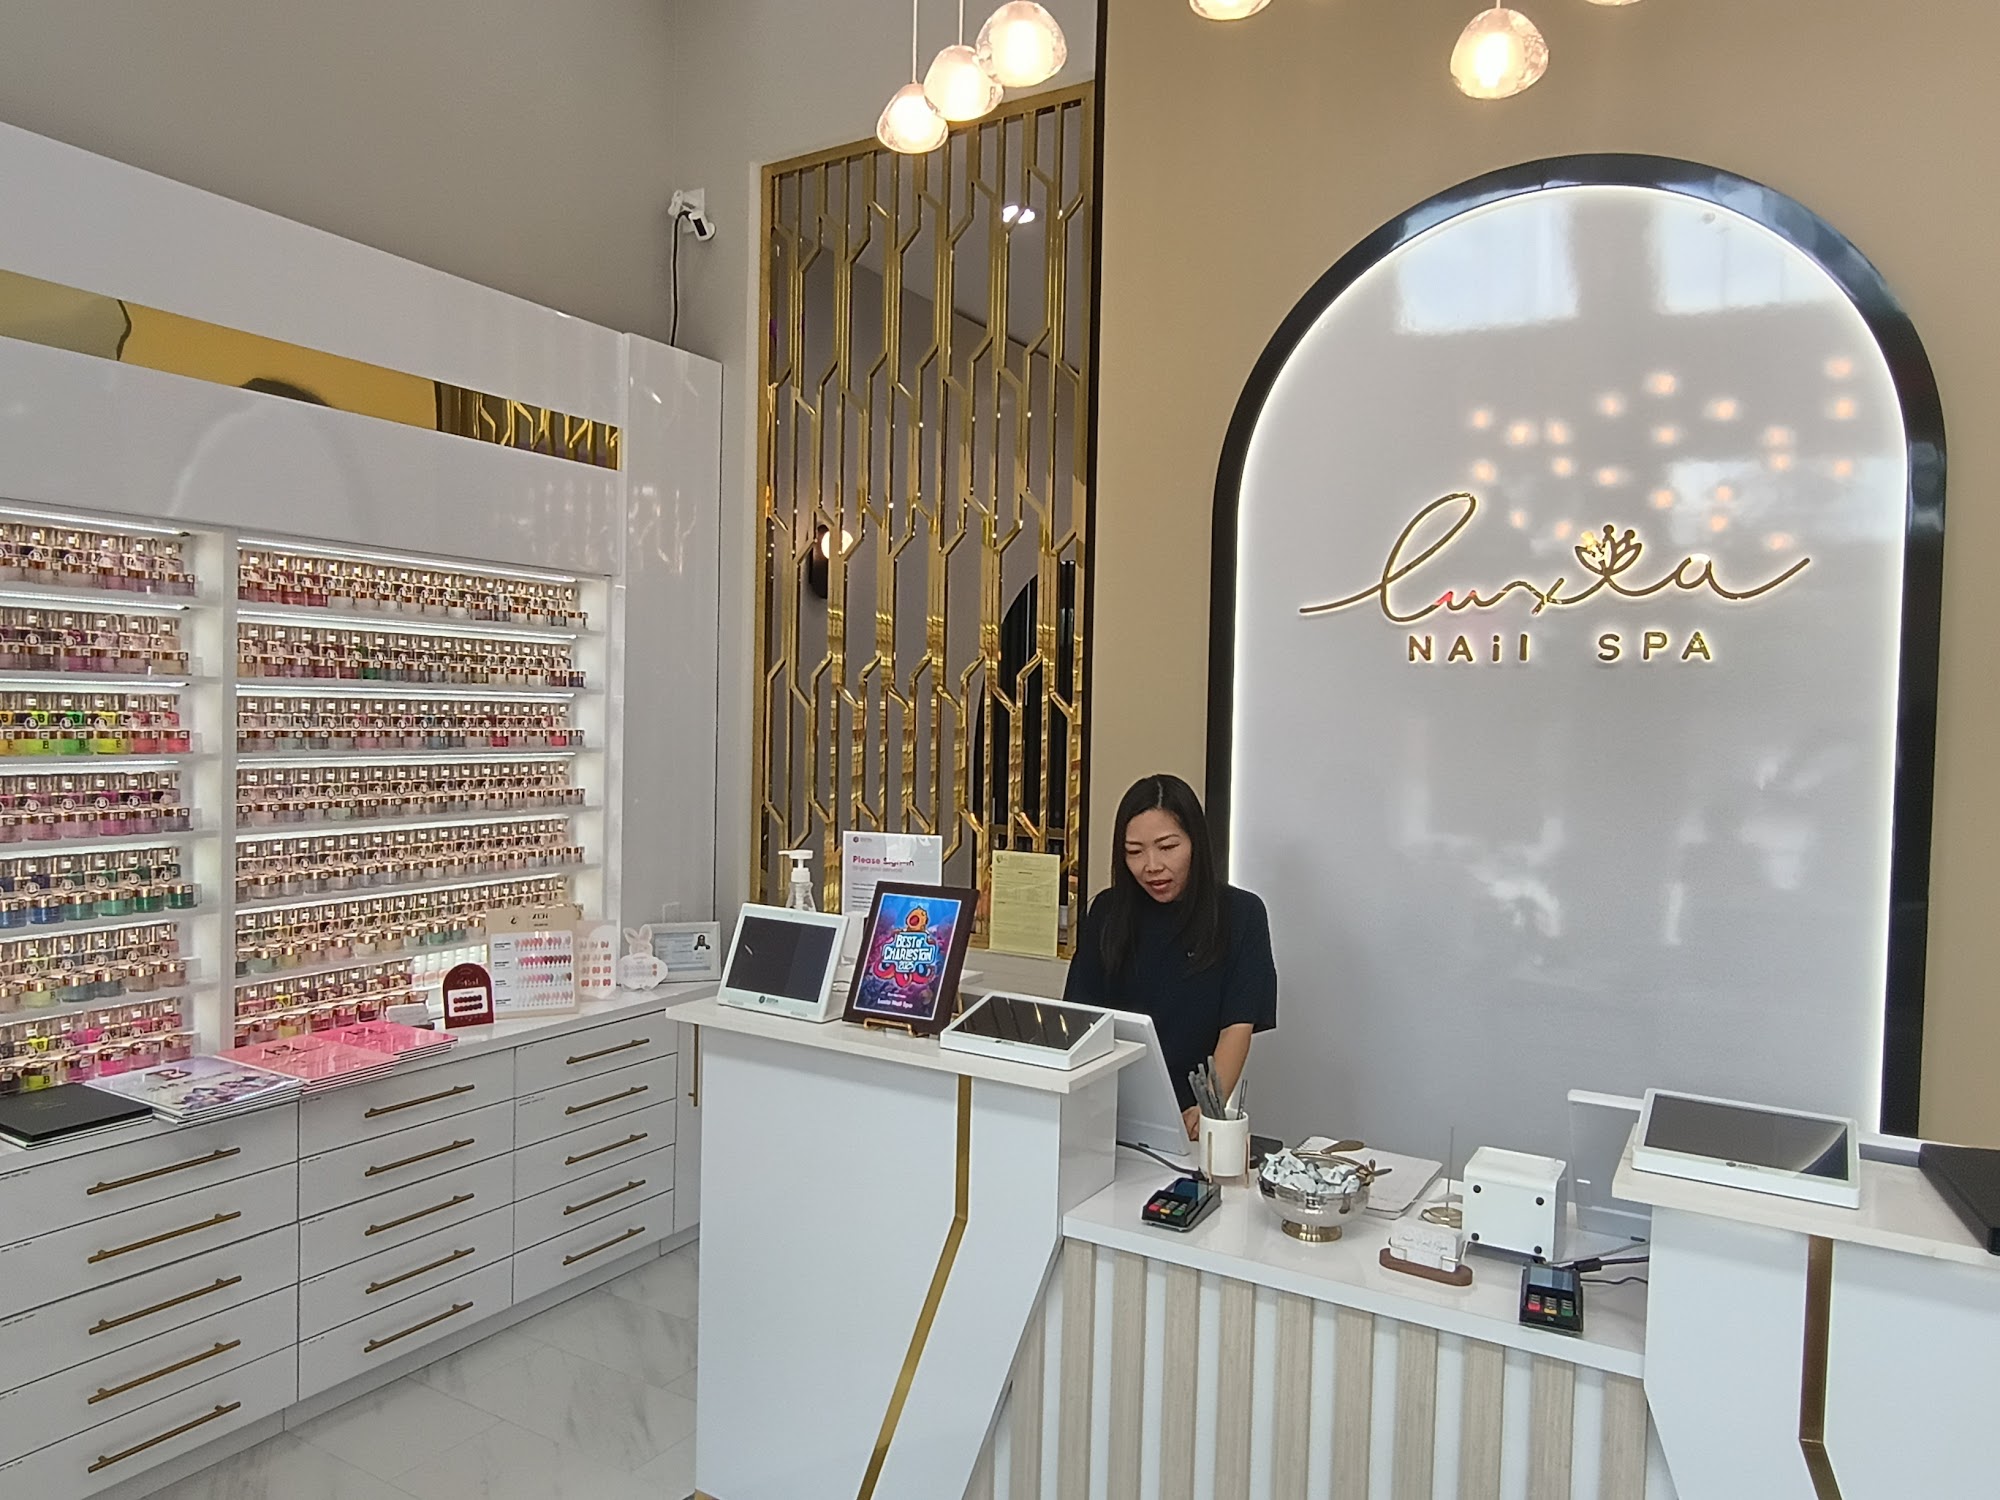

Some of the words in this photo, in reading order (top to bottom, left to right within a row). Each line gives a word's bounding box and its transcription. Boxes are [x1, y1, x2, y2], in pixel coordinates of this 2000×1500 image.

[1597, 631, 1712, 661] SPA
[852, 855, 881, 865] Please
[895, 934, 918, 948] BEST
